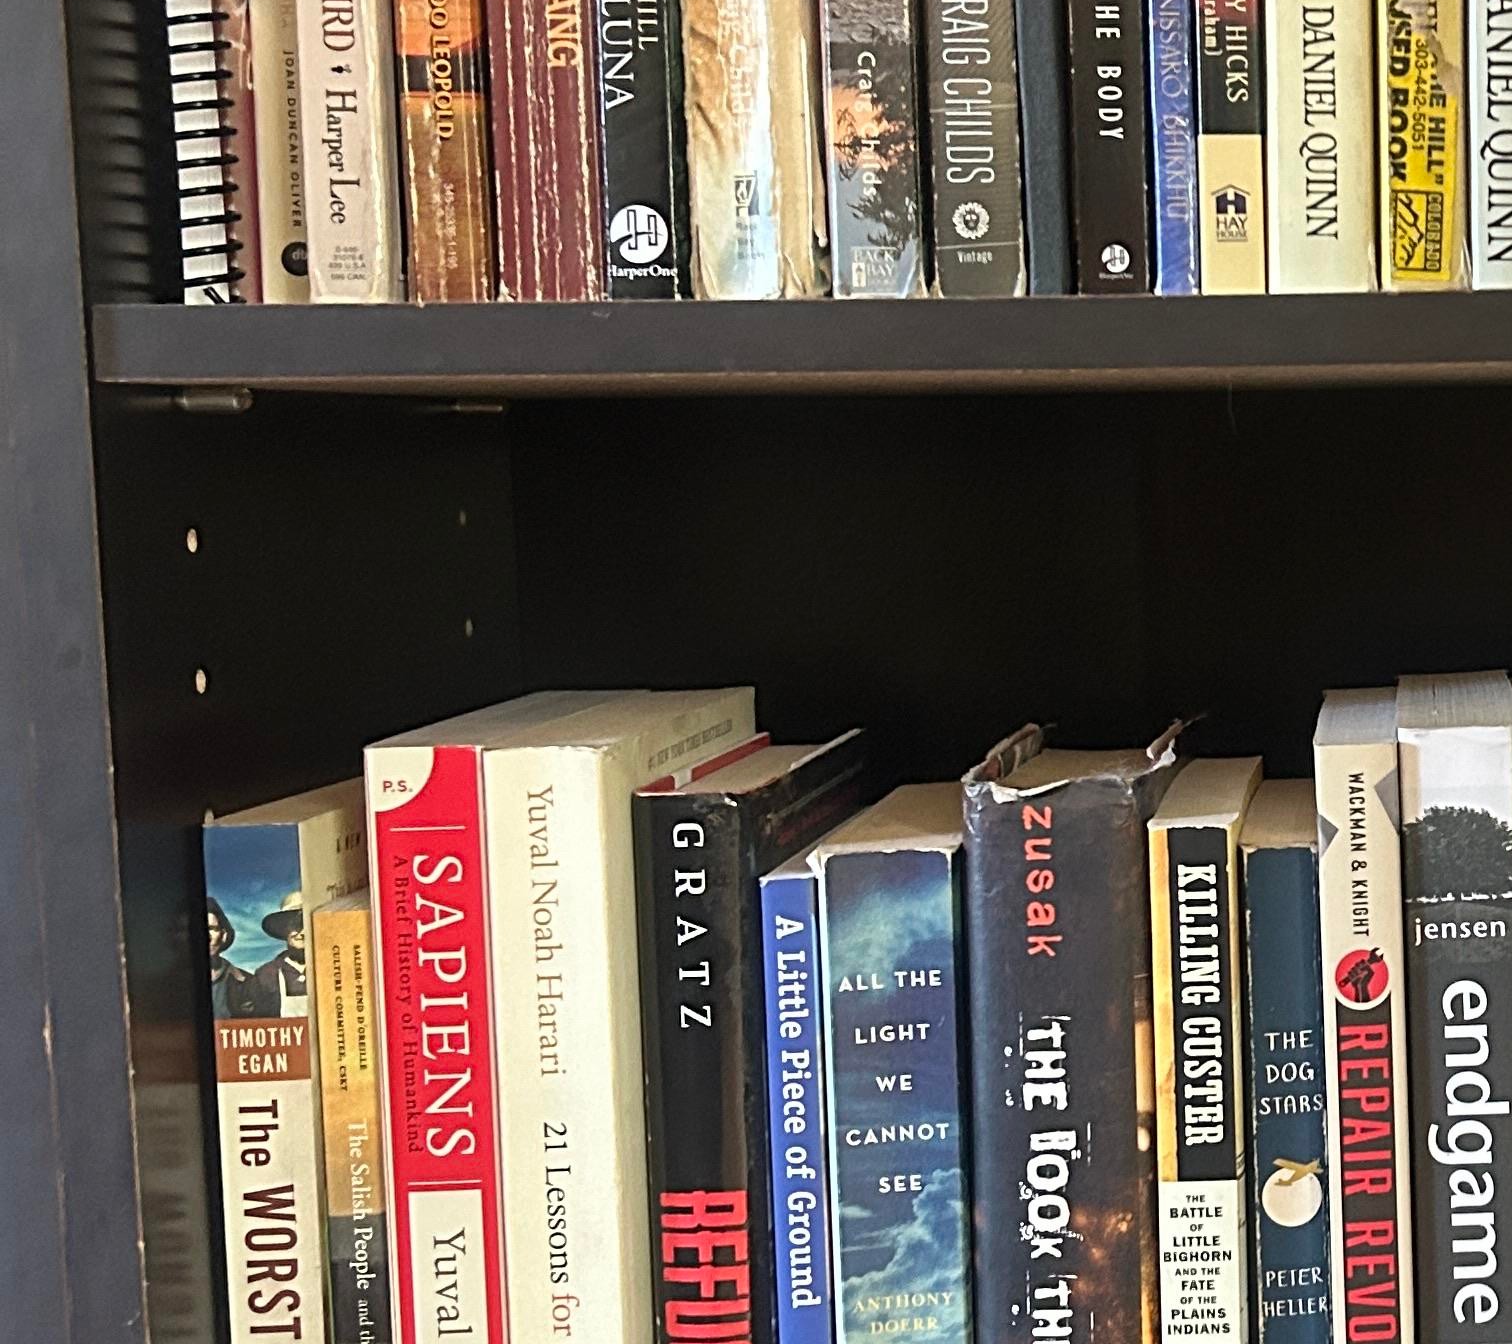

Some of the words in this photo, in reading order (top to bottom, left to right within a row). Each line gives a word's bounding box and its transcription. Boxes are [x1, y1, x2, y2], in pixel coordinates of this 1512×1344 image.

[1097, 65, 1125, 141] BODY
[1301, 6, 1336, 127] DANIEL
[322, 89, 357, 172] Harper
[944, 77, 995, 185] CHILDS
[328, 178, 359, 224] Lee
[1300, 132, 1339, 239] QUINN
[527, 786, 558, 869] Yuval
[1349, 773, 1366, 853] WACKMAN
[1021, 804, 1063, 958] zusak
[1351, 859, 1367, 871] &
[531, 879, 567, 962] Noah
[673, 822, 712, 1028] GRATZ
[1177, 863, 1220, 1006] KILLING
[1352, 879, 1370, 937] KNIGHT
[412, 854, 476, 1156] SAPIENS
[838, 973, 884, 992] ALL
[894, 969, 943, 987] THE
[219, 1028, 303, 1047] TIMOTHY
[238, 1055, 288, 1074] EGAN
[535, 973, 567, 1076] Harari
[854, 1023, 931, 1044] LIGHT
[876, 1074, 914, 1093] WE
[1182, 1016, 1224, 1146] CUSTER
[1340, 1023, 1392, 1195] REPAIR
[238, 1100, 280, 1166] The
[845, 1122, 950, 1146] CANNOT
[1427, 978, 1510, 1324] endgame
[879, 1175, 923, 1193] SEE
[243, 1184, 301, 1339] WORST
[433, 1228, 471, 1337] Yuval
[1264, 1268, 1323, 1288] PETER
[1262, 1298, 1327, 1317] HELLER
